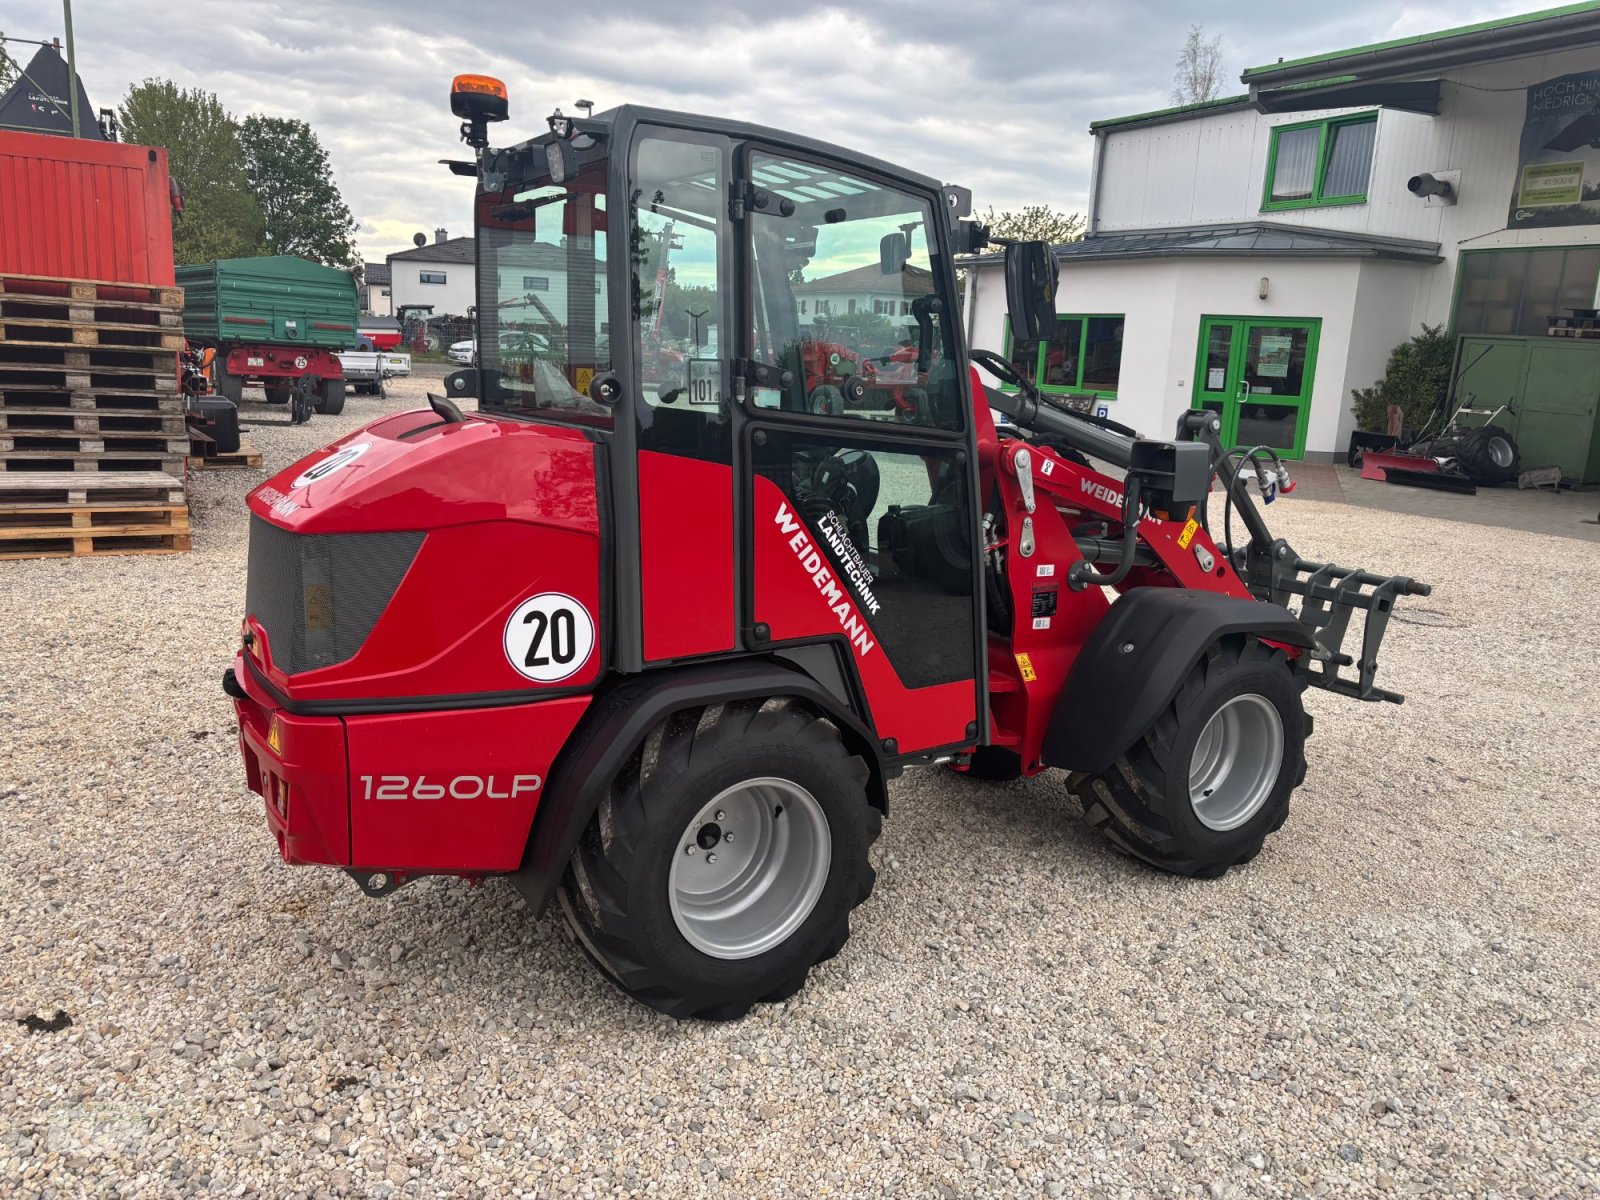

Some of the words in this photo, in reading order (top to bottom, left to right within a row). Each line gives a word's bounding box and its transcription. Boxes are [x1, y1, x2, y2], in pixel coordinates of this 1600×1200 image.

[1533, 82, 1576, 102] HOCH
[297, 358, 306, 367] 25
[693, 379, 712, 402] 101
[303, 449, 359, 480] 20
[826, 509, 874, 585] SCHLACHTBAUER
[774, 502, 874, 656] WEIDEMANN
[817, 516, 881, 615] LANDTECHNIK
[523, 608, 576, 667] 20
[360, 774, 542, 800] 1260LP
